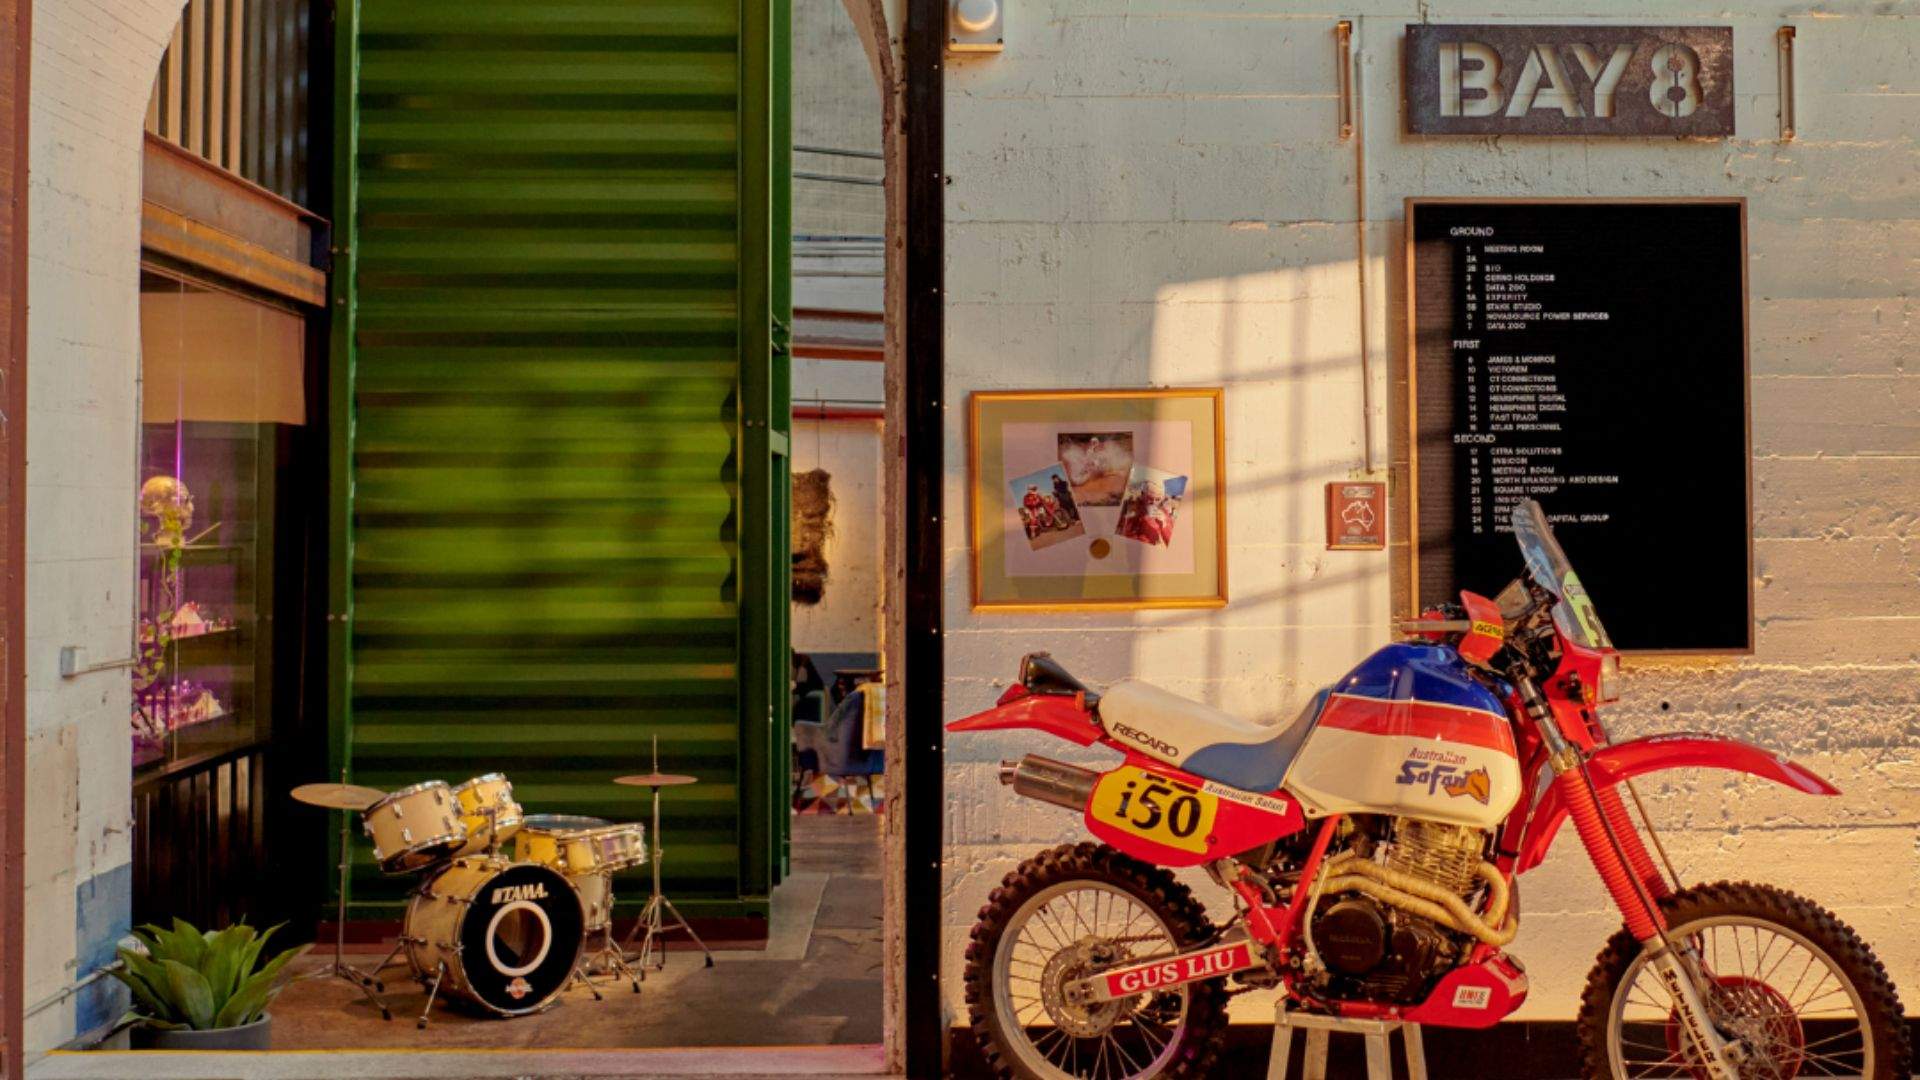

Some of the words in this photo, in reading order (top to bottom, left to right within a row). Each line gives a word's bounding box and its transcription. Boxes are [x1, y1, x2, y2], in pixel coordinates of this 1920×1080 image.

[1438, 41, 1637, 118] BAY
[1649, 42, 1704, 118] 8
[1449, 226, 1494, 237] GROUND
[1484, 245, 1518, 253] MEETING
[1519, 245, 1544, 253] ROOM
[1514, 274, 1555, 282] HOLDINGS
[1485, 283, 1506, 292] DATA
[1512, 302, 1542, 311] STUDIO
[1542, 312, 1571, 320] POWER
[1572, 311, 1610, 321] SERVICES
[1486, 322, 1506, 330] DATA
[1452, 339, 1481, 349] FIRST
[1487, 355, 1514, 364] JAMES
[1500, 375, 1556, 383] CONNECTIONS
[1501, 384, 1557, 393] CONNECTIONS
[1489, 394, 1535, 402] HEMISPHERE
[1538, 394, 1567, 402] DIGITAL
[1489, 404, 1537, 412] HEMISPHERE
[1539, 404, 1567, 412] DIGITAL
[1516, 423, 1561, 431] PERSONNEL
[1453, 433, 1496, 444] SECOND
[1515, 447, 1562, 455] SOLUTIONS
[1491, 466, 1526, 475] MEETING
[1529, 466, 1555, 475] ROOM
[1493, 476, 1521, 484] NORTH
[1521, 476, 1566, 484] BRANDING
[1569, 475, 1587, 484] AND
[1586, 475, 1619, 484] DESIGN
[1493, 485, 1524, 494] SQUARE
[1530, 486, 1558, 494] GROUP
[1580, 514, 1610, 523] GROUP
[1113, 722, 1179, 757] RECARO
[1407, 747, 1467, 765] Australian
[1204, 783, 1253, 806] Australian
[1120, 963, 1179, 991] GUS
[1187, 949, 1235, 977] LIU
